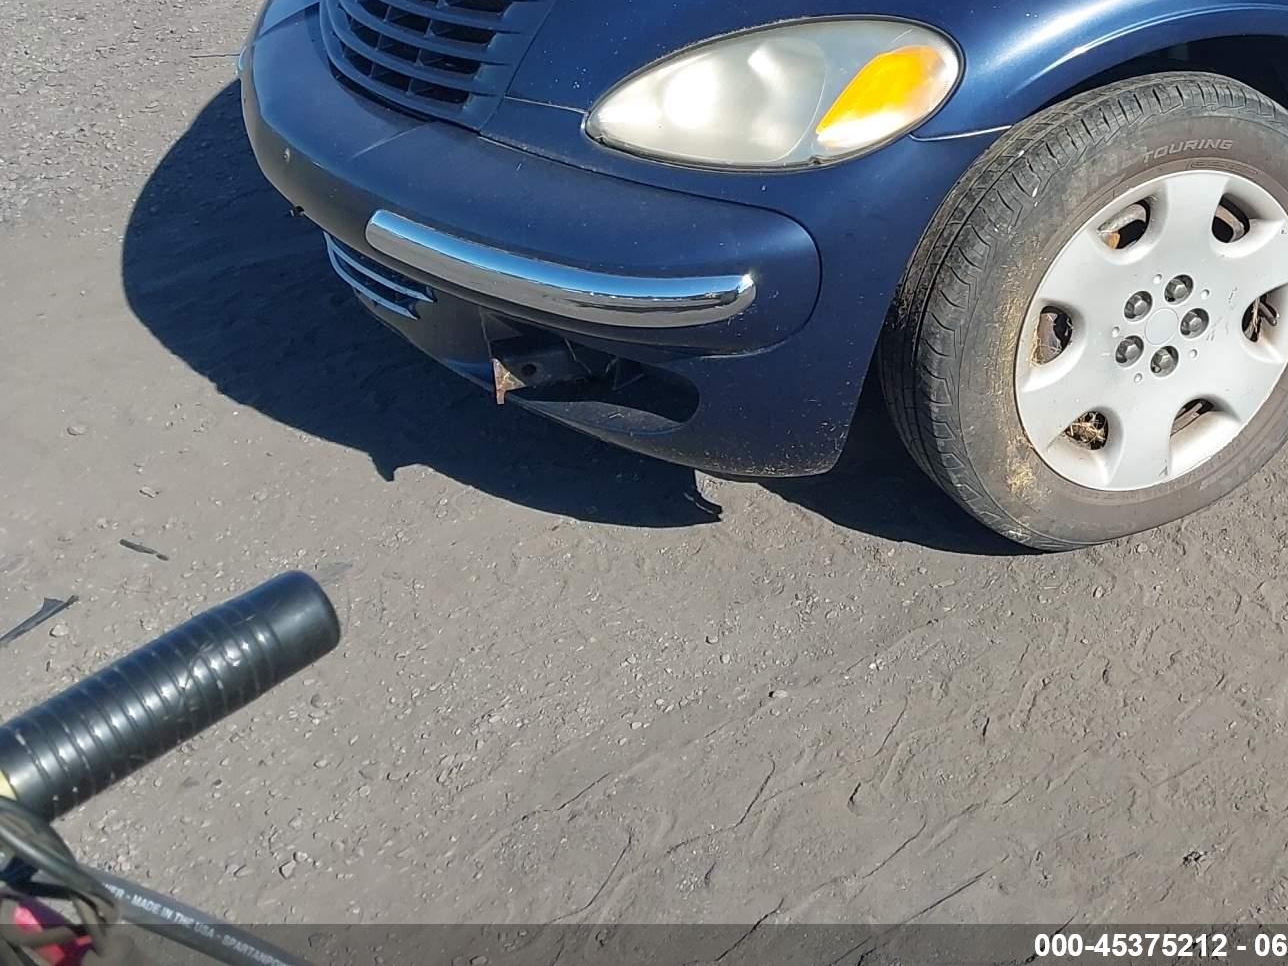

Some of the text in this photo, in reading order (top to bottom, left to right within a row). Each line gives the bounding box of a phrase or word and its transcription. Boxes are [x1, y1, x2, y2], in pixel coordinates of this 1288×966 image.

[1143, 139, 1235, 163] TOURING
[131, 894, 161, 914] MADE
[160, 907, 174, 920] IN
[174, 912, 195, 929] THE
[193, 921, 215, 938] USA
